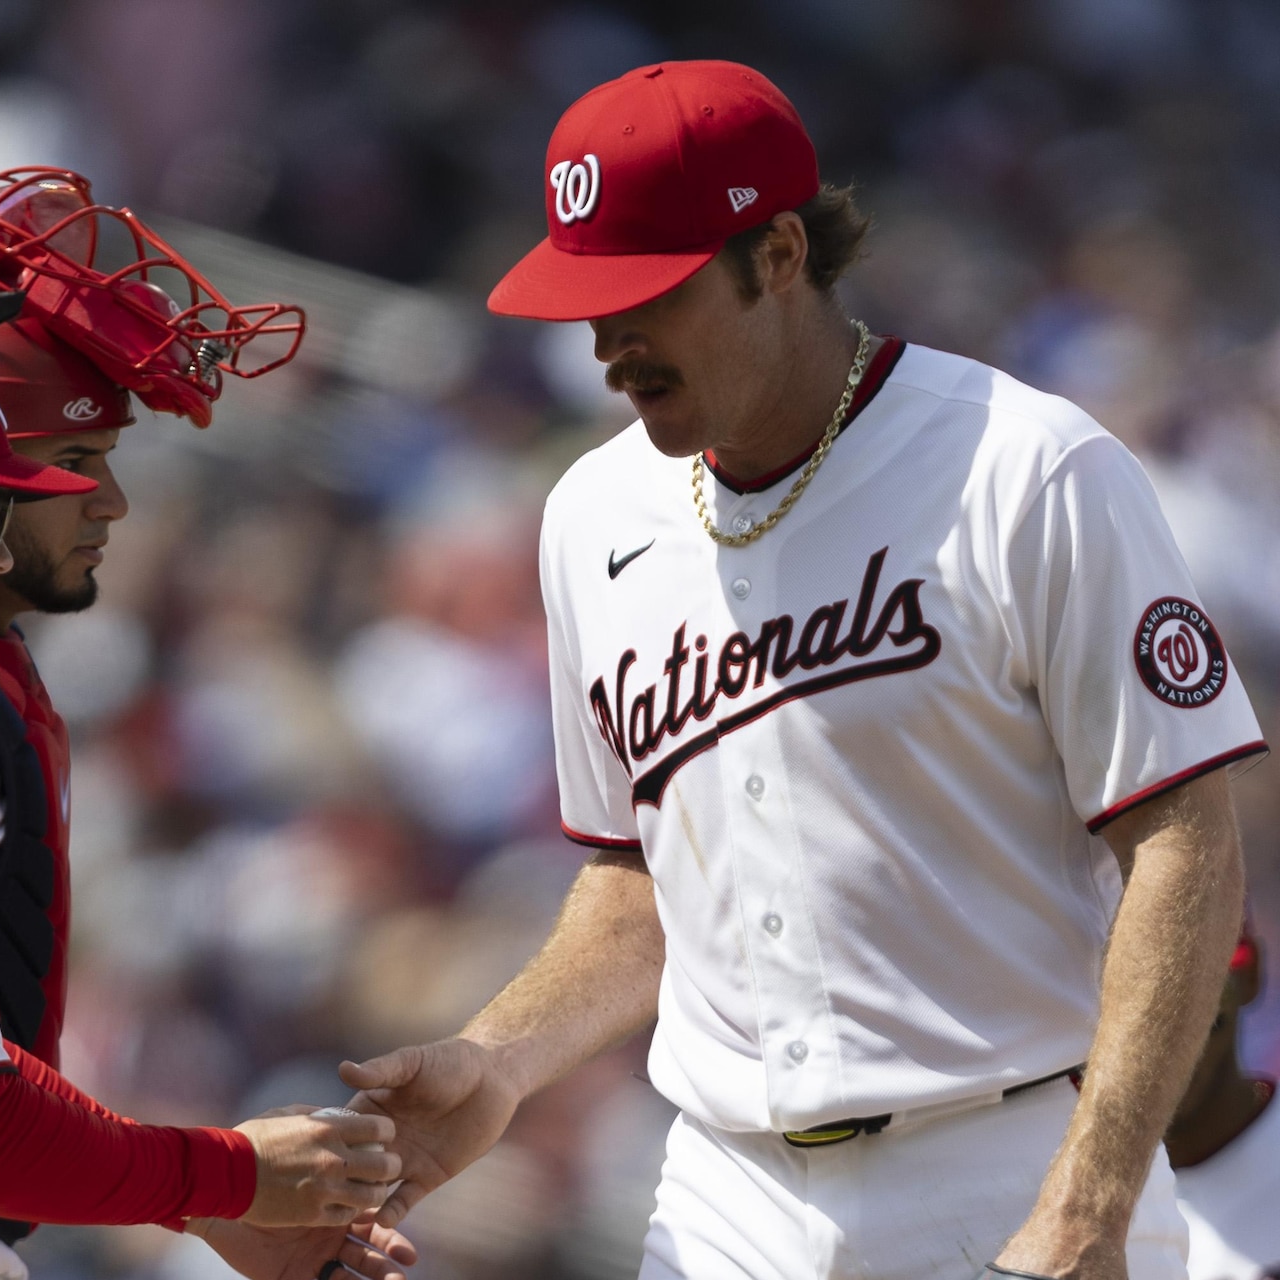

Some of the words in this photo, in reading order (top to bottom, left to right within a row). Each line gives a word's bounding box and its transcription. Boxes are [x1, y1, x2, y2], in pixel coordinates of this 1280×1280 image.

[550, 154, 601, 225] W
[1140, 602, 1209, 656] WASHINGTON
[590, 546, 937, 795] Nationals
[1157, 659, 1223, 703] NATIONALS
